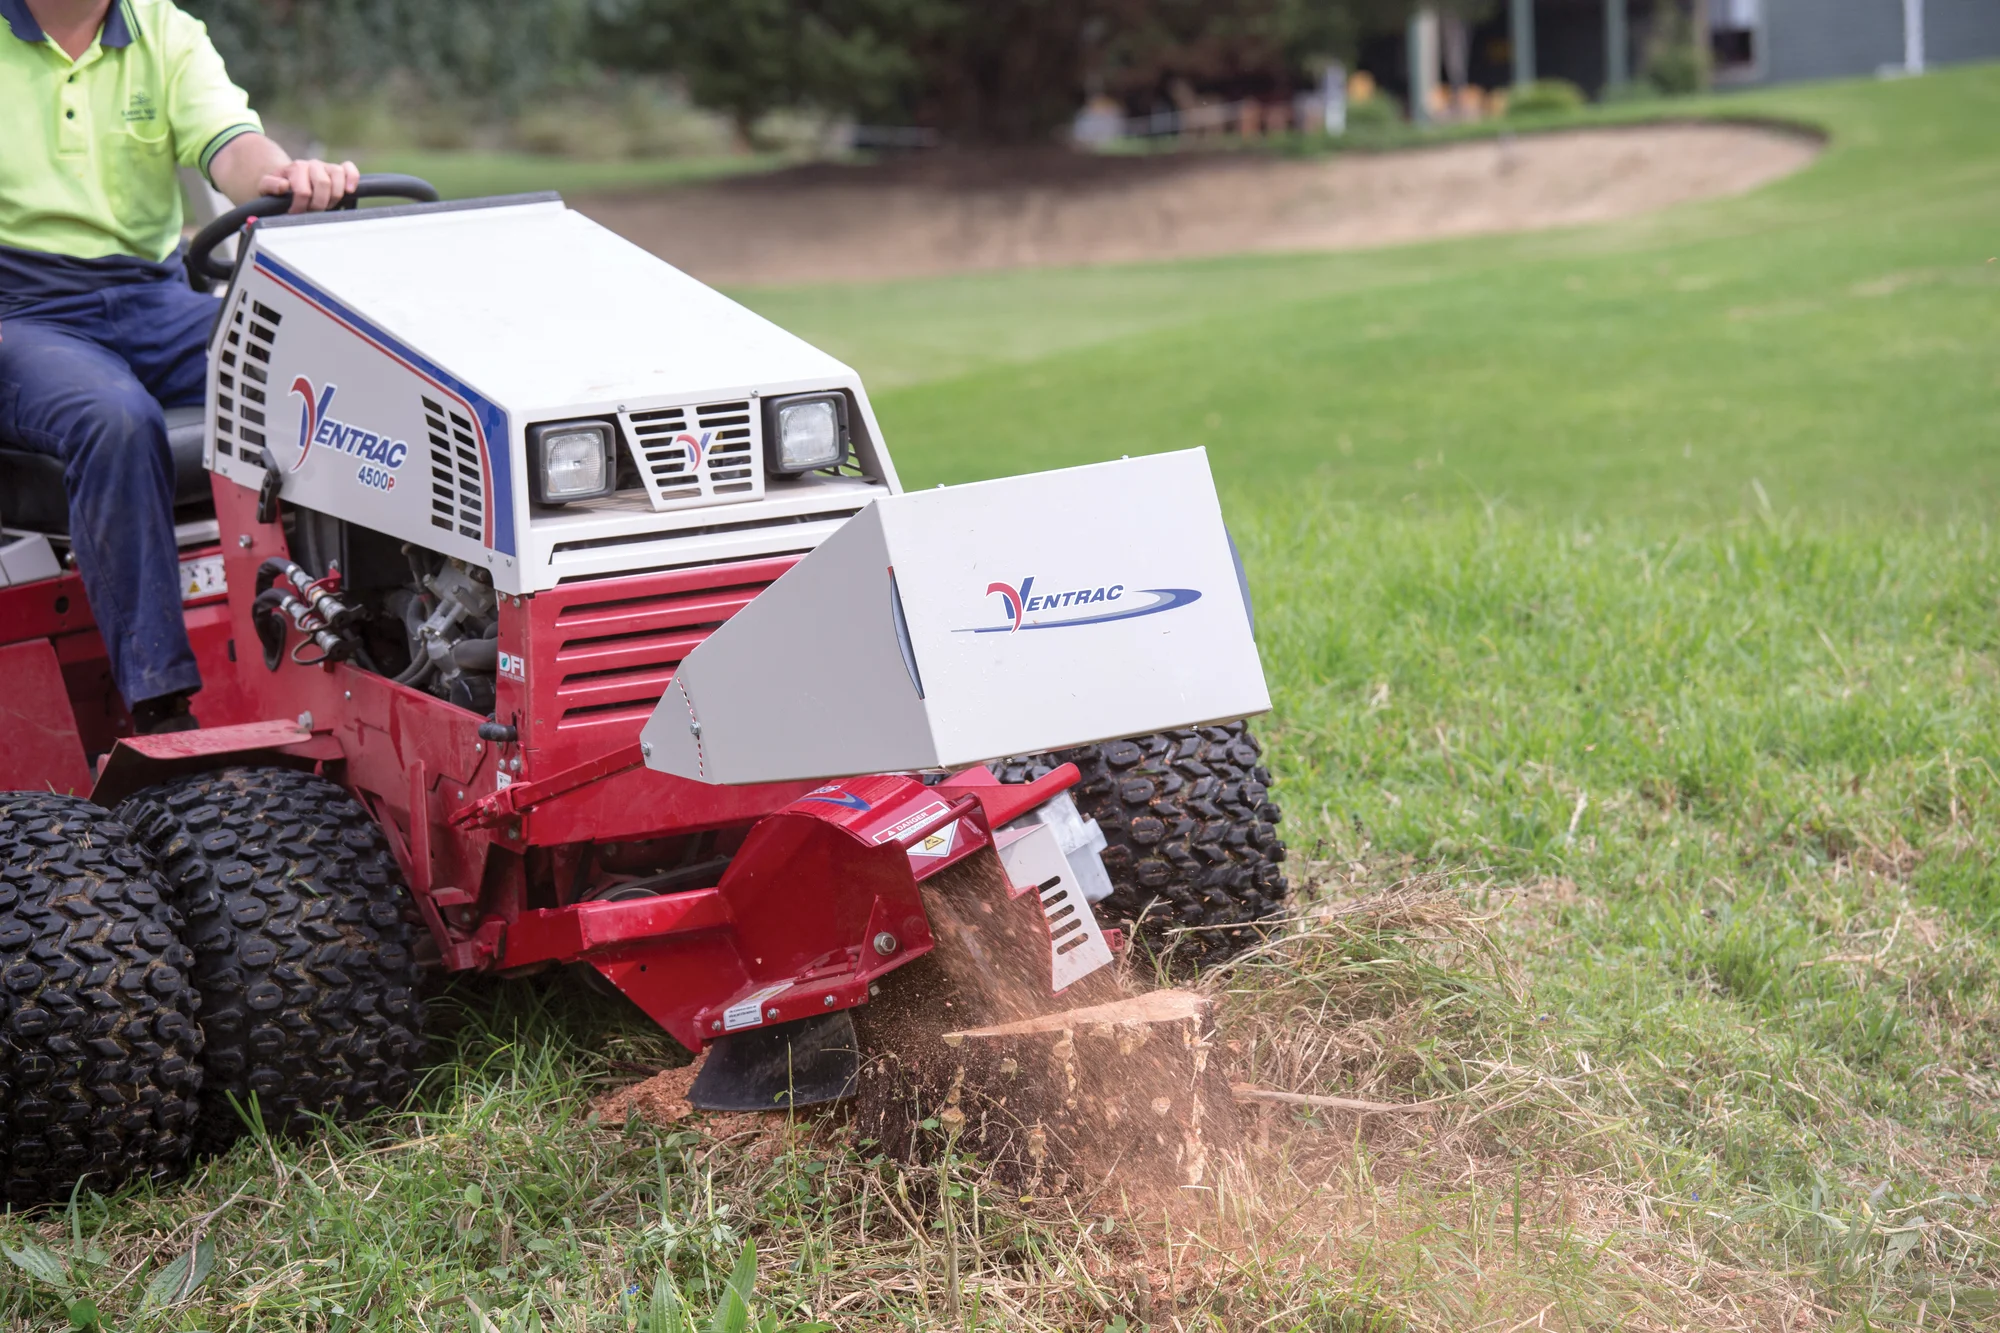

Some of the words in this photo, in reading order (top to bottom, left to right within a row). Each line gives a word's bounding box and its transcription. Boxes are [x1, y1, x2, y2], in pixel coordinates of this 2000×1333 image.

[290, 376, 408, 472] VENTRAC
[357, 465, 395, 491] 4500P
[985, 576, 1124, 634] VENTRAC
[498, 651, 525, 677] DFI
[896, 811, 929, 831] DANGER
